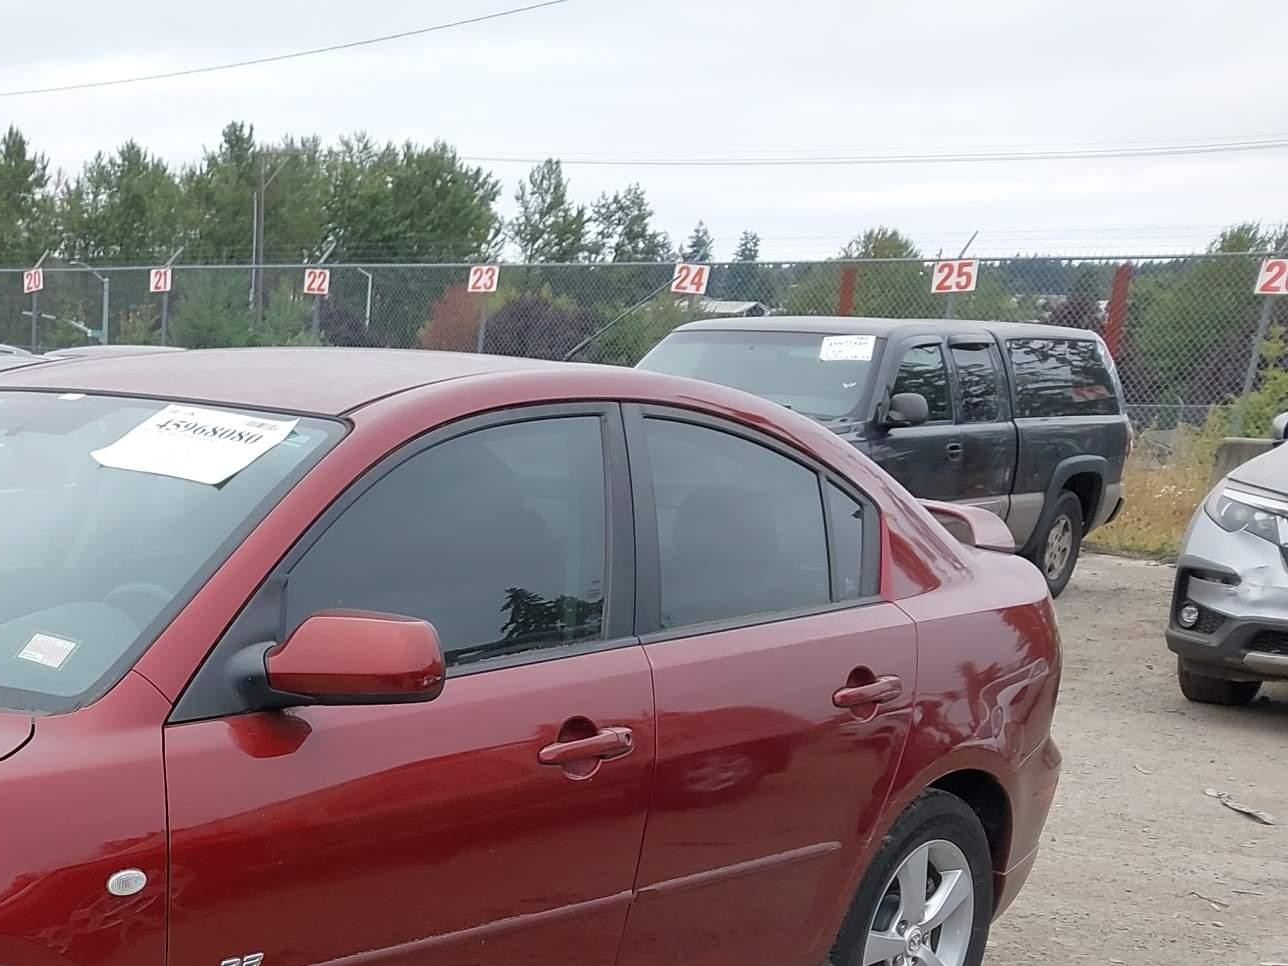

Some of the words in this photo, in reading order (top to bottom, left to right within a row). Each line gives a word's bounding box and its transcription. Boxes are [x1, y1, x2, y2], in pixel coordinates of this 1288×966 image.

[26, 271, 41, 291] 20
[154, 270, 167, 290] 21
[306, 270, 326, 294] 22
[471, 267, 495, 290] 23
[674, 266, 705, 292] 24
[935, 261, 973, 292] 25
[1260, 261, 1288, 292] 2
[156, 419, 263, 445] 45968080
